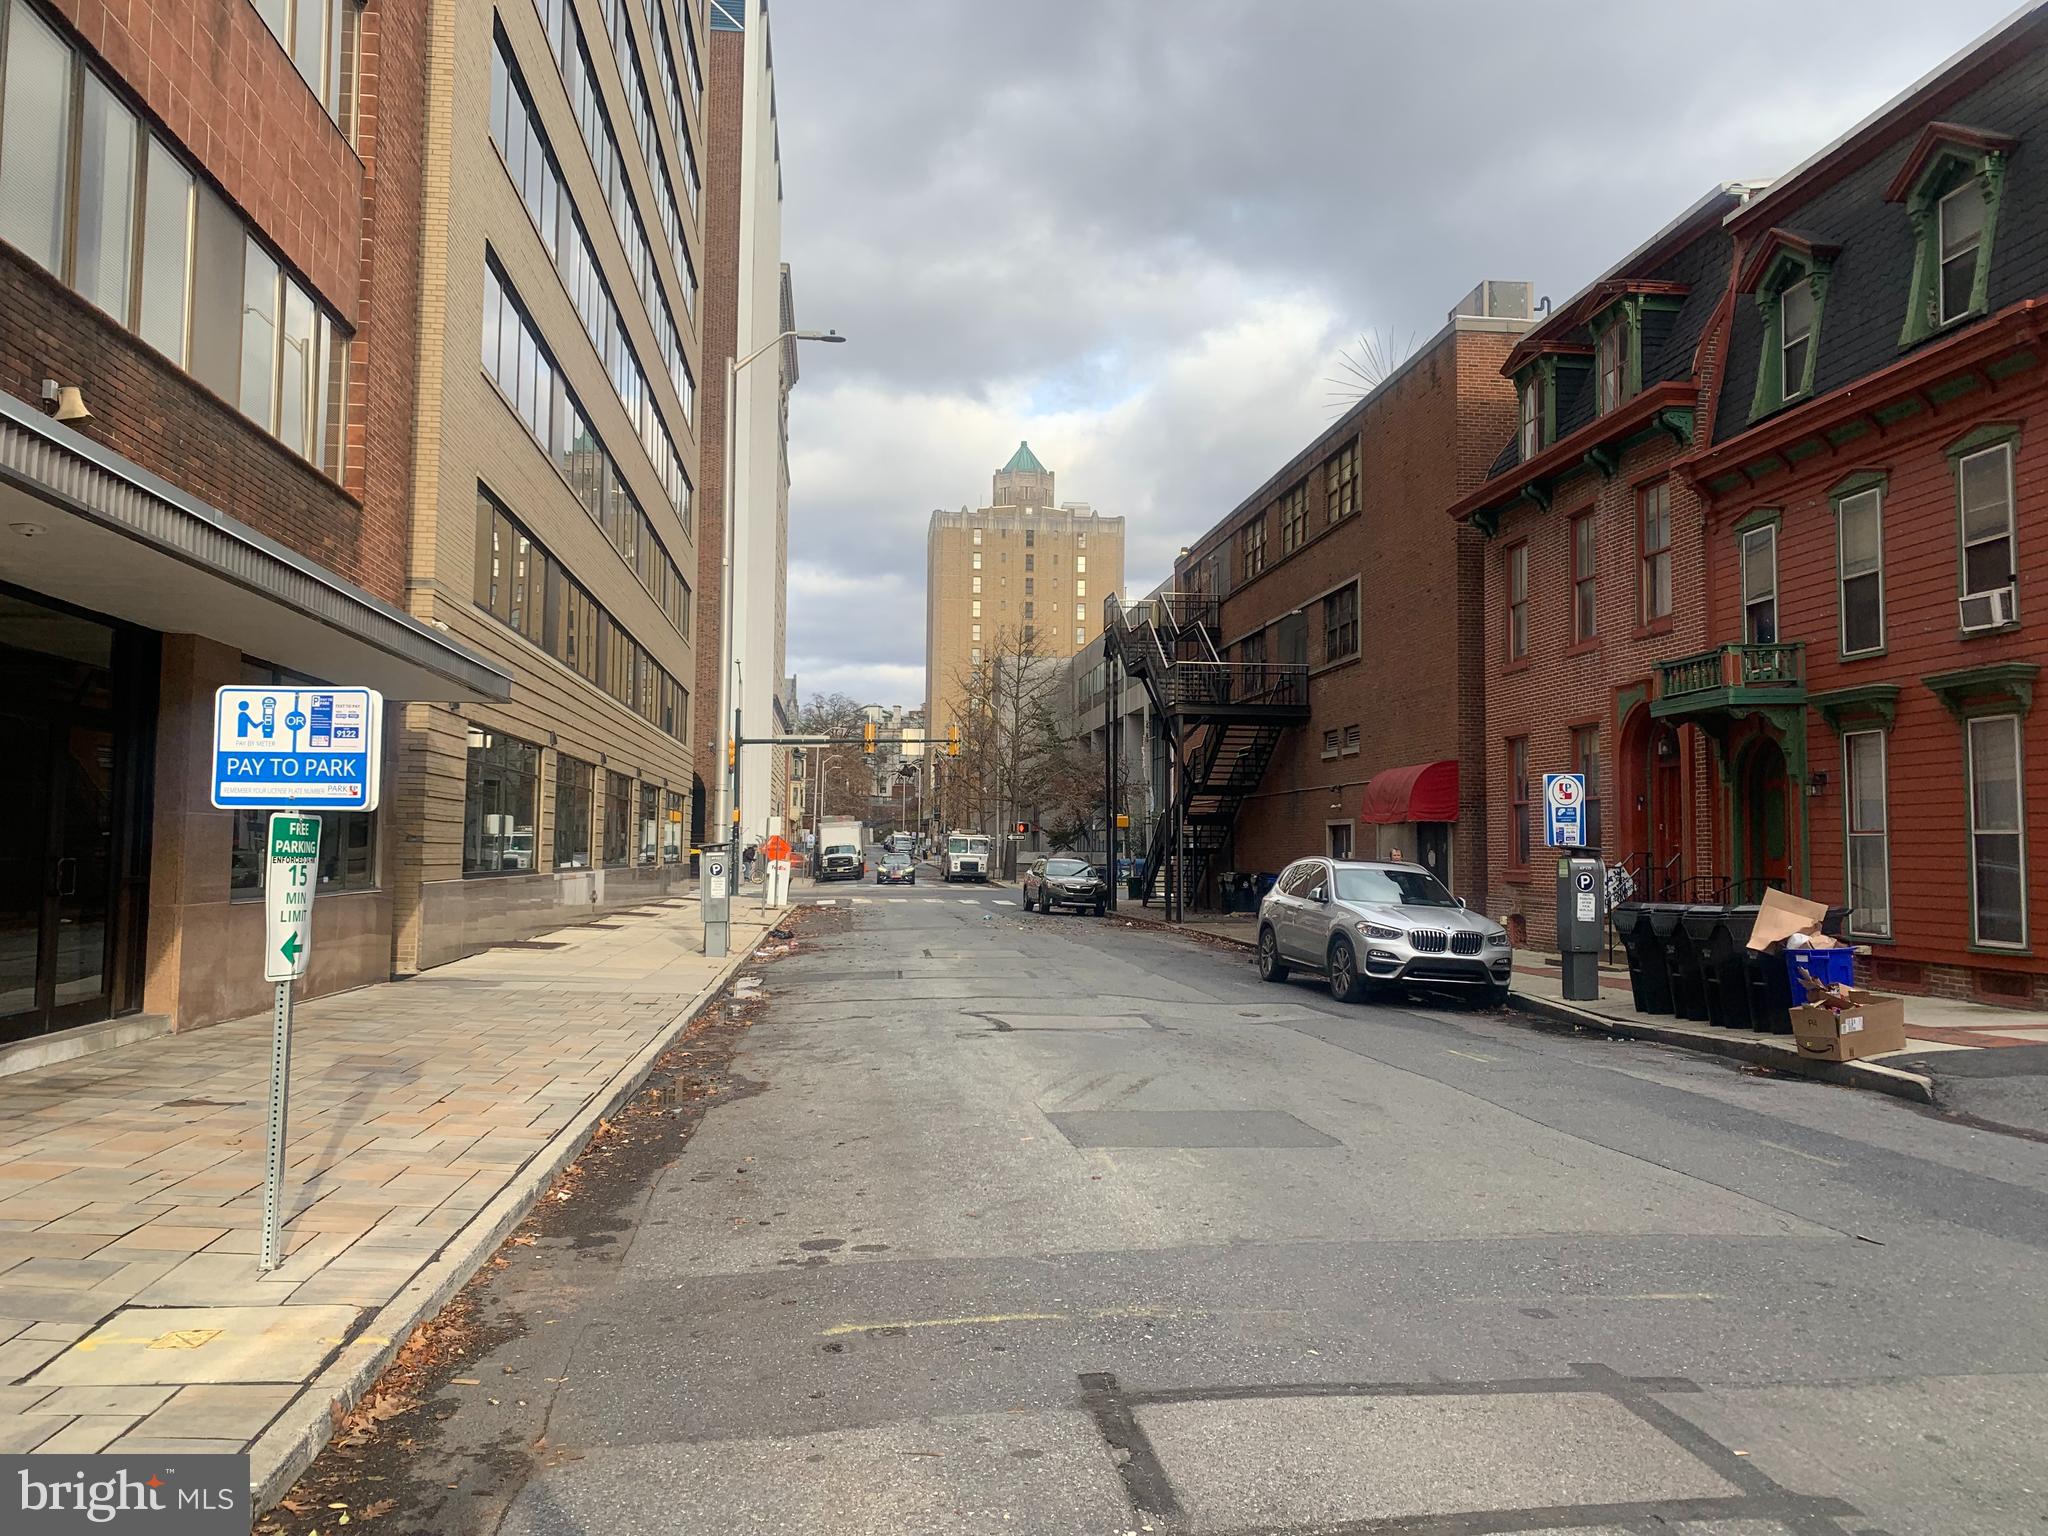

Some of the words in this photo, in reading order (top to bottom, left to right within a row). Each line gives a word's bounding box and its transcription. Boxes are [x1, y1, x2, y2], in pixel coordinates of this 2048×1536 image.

[287, 717, 304, 726] OR
[336, 730, 356, 738] 9122
[227, 758, 268, 776] PAY
[270, 758, 299, 776] TO
[305, 759, 357, 777] PARK
[327, 785, 347, 793] PARK
[289, 823, 310, 836] FREE
[275, 840, 316, 854] PARKING
[272, 856, 305, 864] ENFORCED
[288, 865, 307, 887] 15
[712, 865, 721, 874] P
[1580, 875, 1590, 889] P
[286, 892, 307, 905] MIN
[280, 910, 307, 923] LIMIT
